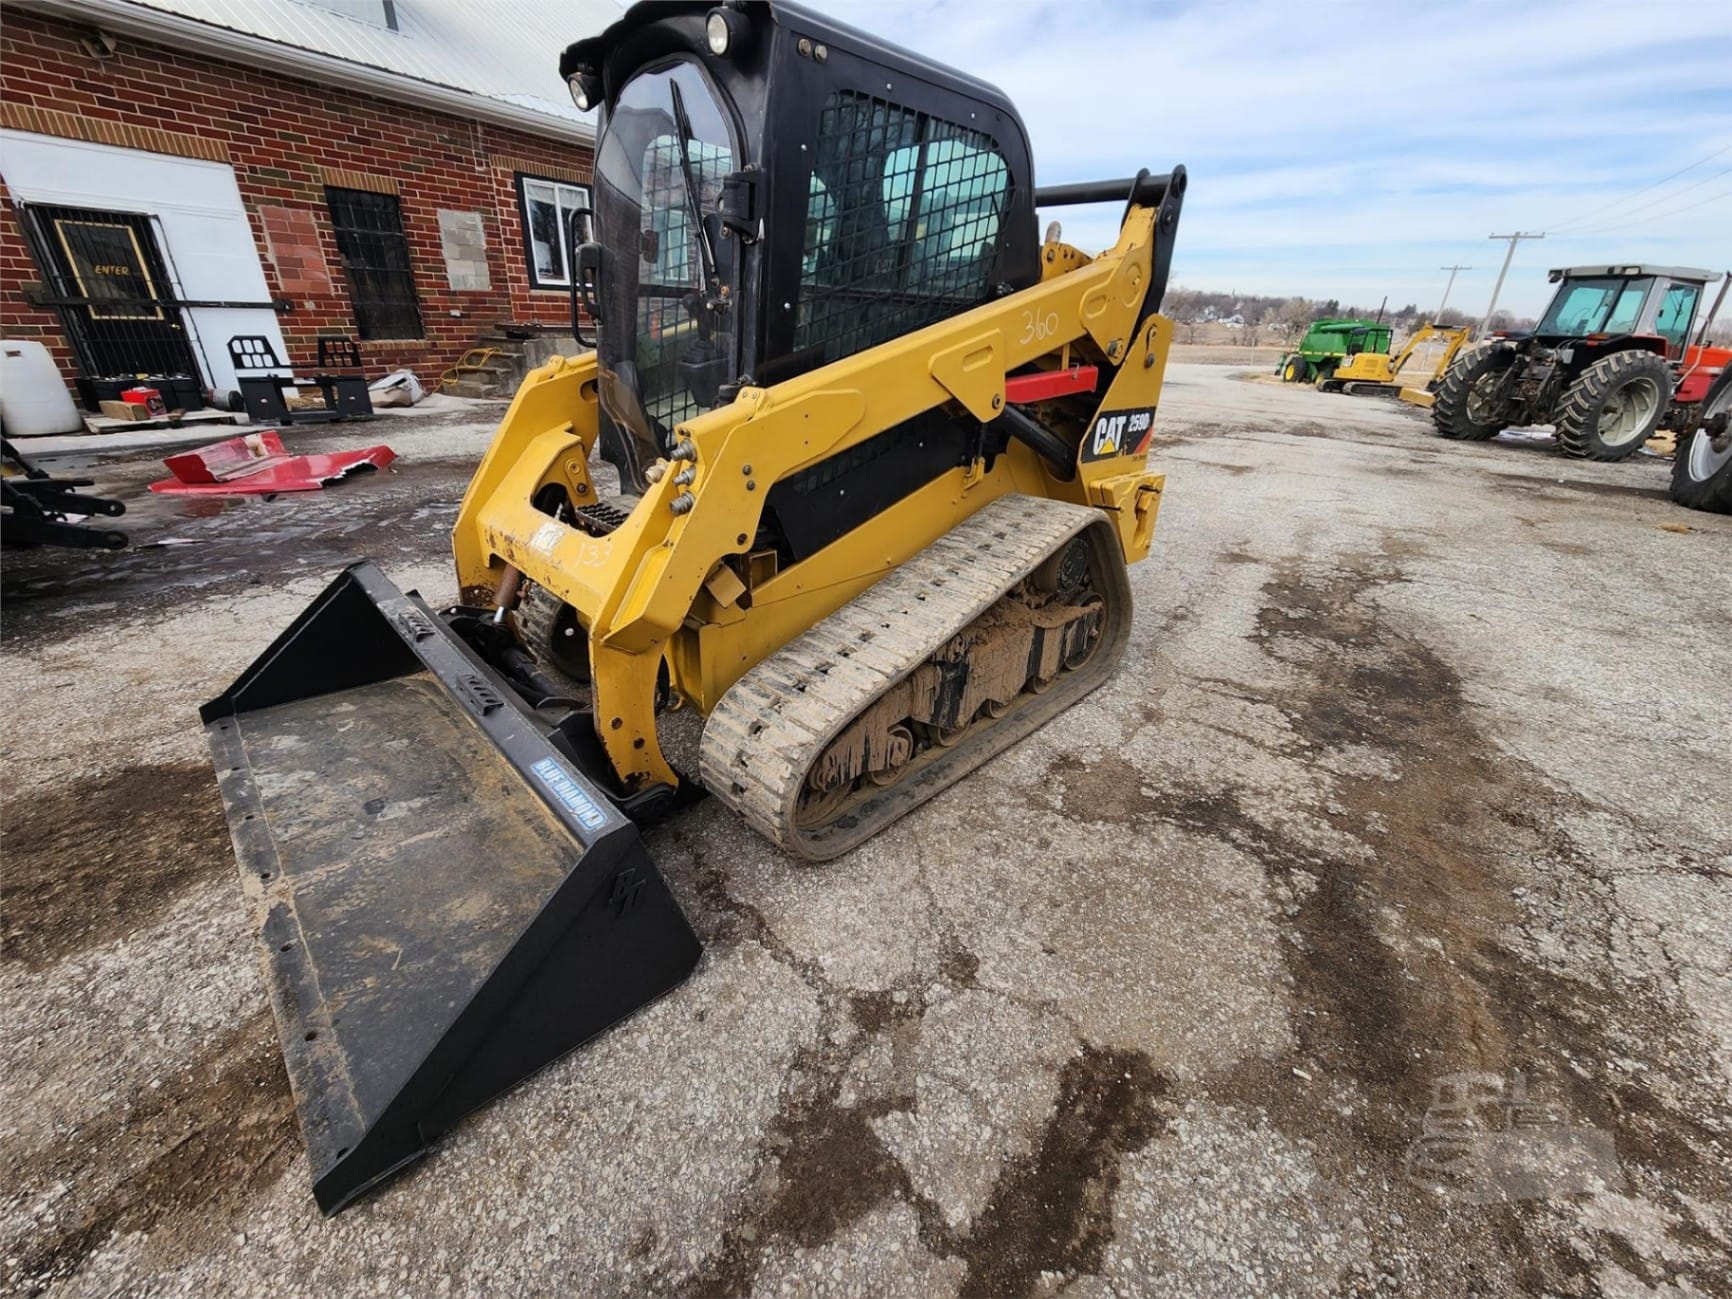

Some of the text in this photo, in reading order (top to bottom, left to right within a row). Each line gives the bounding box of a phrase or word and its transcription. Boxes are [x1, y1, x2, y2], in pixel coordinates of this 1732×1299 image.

[94, 264, 129, 276] ENTER
[1019, 306, 1059, 345] 360
[1093, 412, 1150, 455] CAT 259D
[533, 758, 606, 828] BLUE DIAMOND
